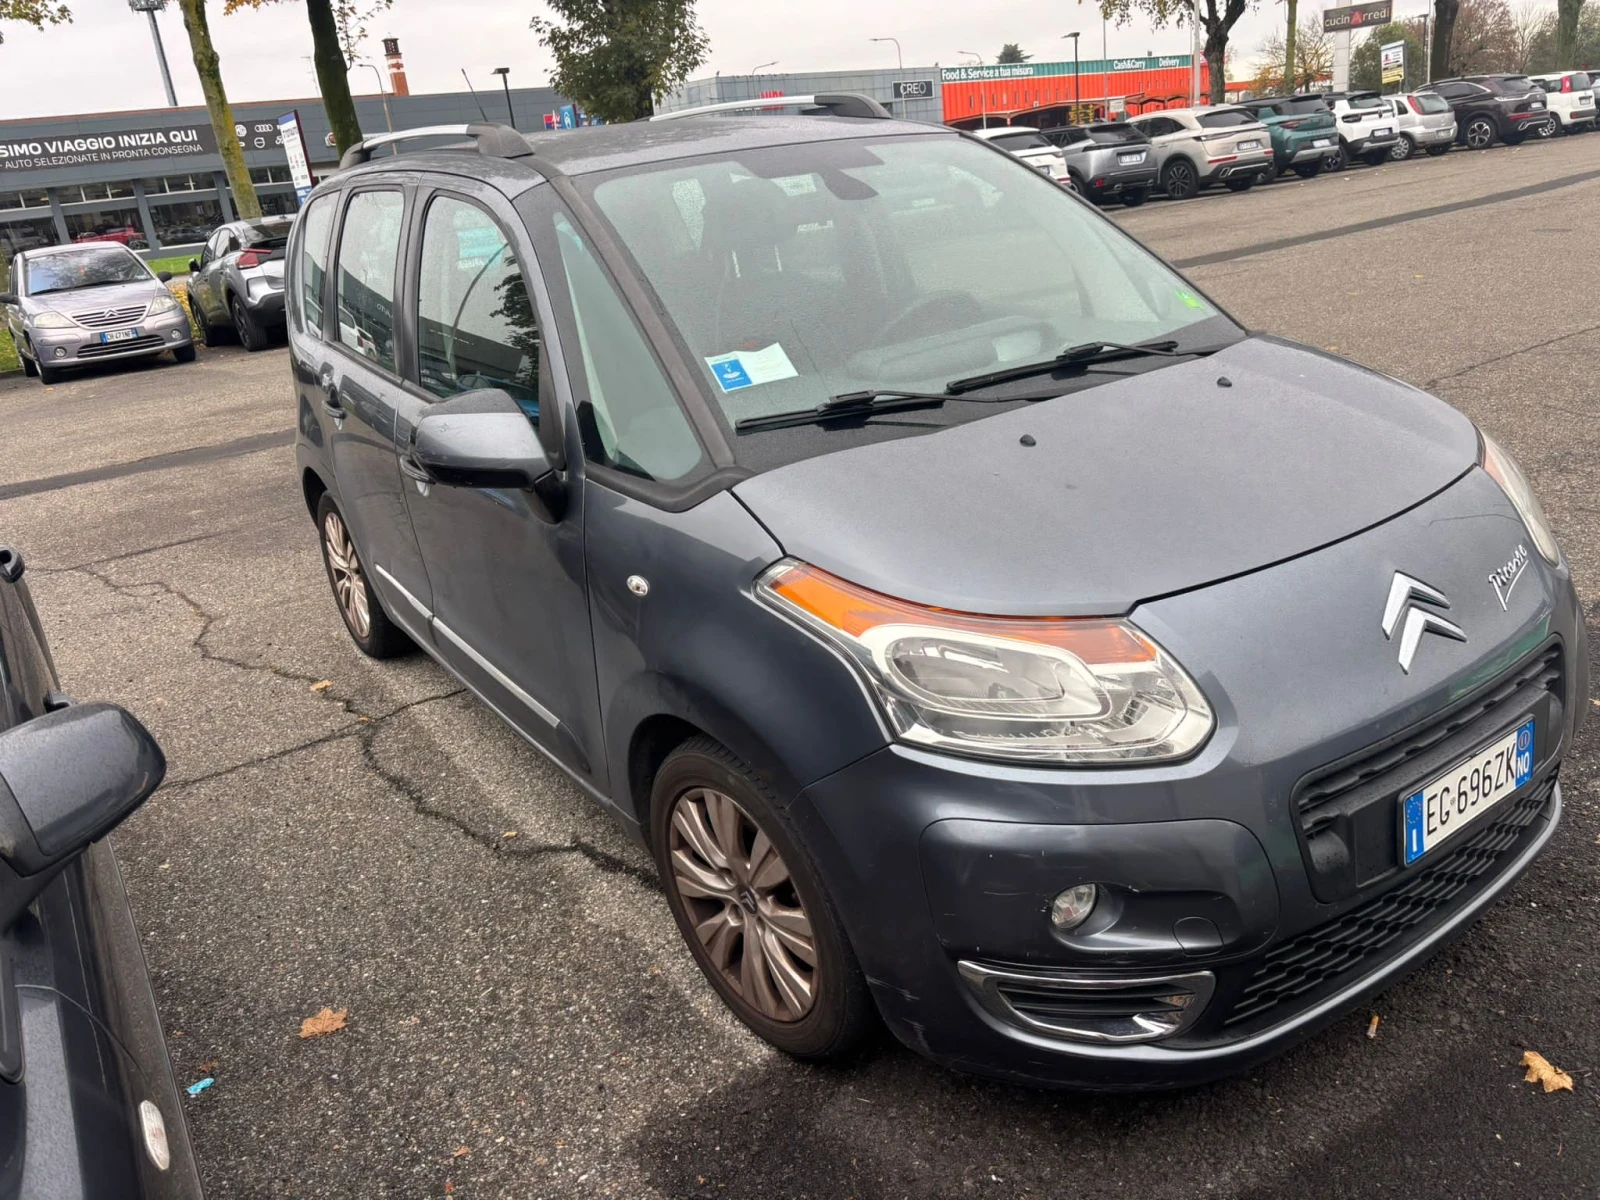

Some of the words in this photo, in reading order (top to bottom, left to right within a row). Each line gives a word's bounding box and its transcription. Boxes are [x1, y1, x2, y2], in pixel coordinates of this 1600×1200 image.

[941, 68, 960, 80] Food
[960, 68, 967, 79] &
[968, 67, 994, 79] Service
[999, 66, 1011, 76] tua
[1011, 65, 1034, 76] misura
[1158, 58, 1180, 67] Delivery
[900, 82, 927, 95] CREO
[44, 136, 116, 154] VIAGGIO
[118, 132, 168, 147] INIZIA
[169, 129, 198, 143] QUI
[5, 158, 33, 169] AUTO
[33, 153, 99, 167] SELEZIONATE
[100, 152, 111, 161] IN
[112, 148, 150, 159] PRONTA
[151, 144, 204, 156] CONSEGNA
[1489, 544, 1527, 611] Picasso
[1517, 752, 1530, 778] NO
